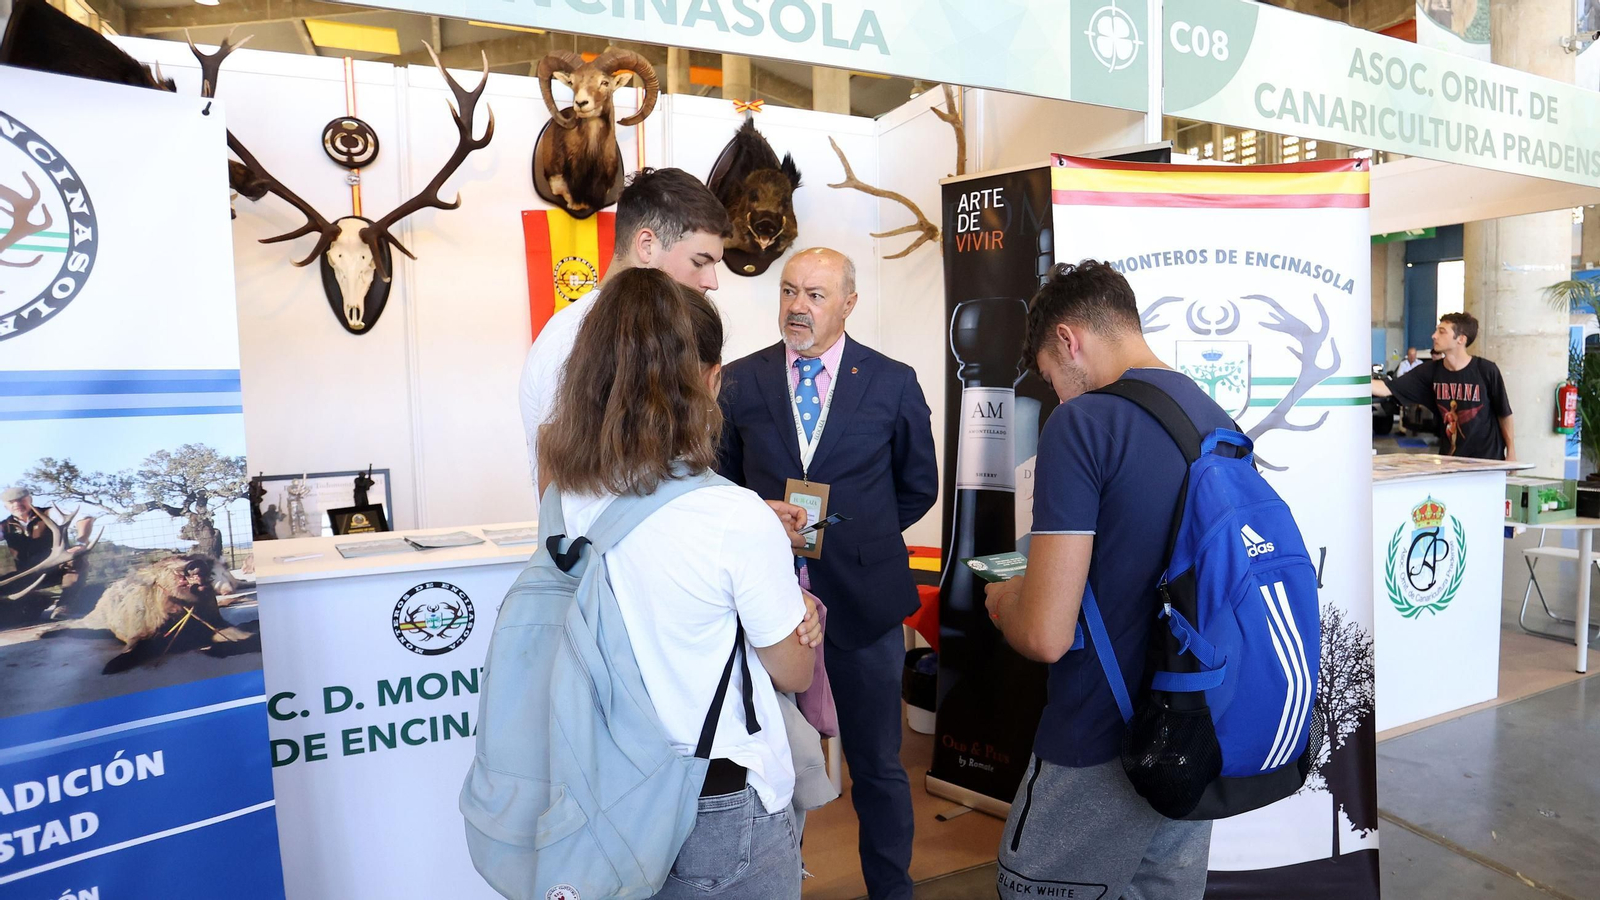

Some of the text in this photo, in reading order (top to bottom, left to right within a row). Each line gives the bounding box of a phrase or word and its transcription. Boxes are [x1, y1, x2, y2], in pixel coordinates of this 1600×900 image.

[501, 0, 890, 56] NASOLA
[1169, 20, 1230, 62] C08
[1347, 47, 1559, 125] ASOC. ORNIT. DE
[1253, 82, 1497, 159] CANARICULTURA
[957, 187, 1005, 213] ARTE
[957, 211, 981, 233] DE
[956, 230, 1004, 253] VIVIR
[1109, 249, 1355, 295] MONTEROS DE ENCINASOLA
[971, 401, 1004, 420] AM
[393, 582, 475, 655] MONTEROS DE ENCINASOLA
[268, 667, 484, 721] C. D. MON
[270, 711, 477, 768] DE ENCIN
[998, 872, 1075, 899] BLACK WHITE
